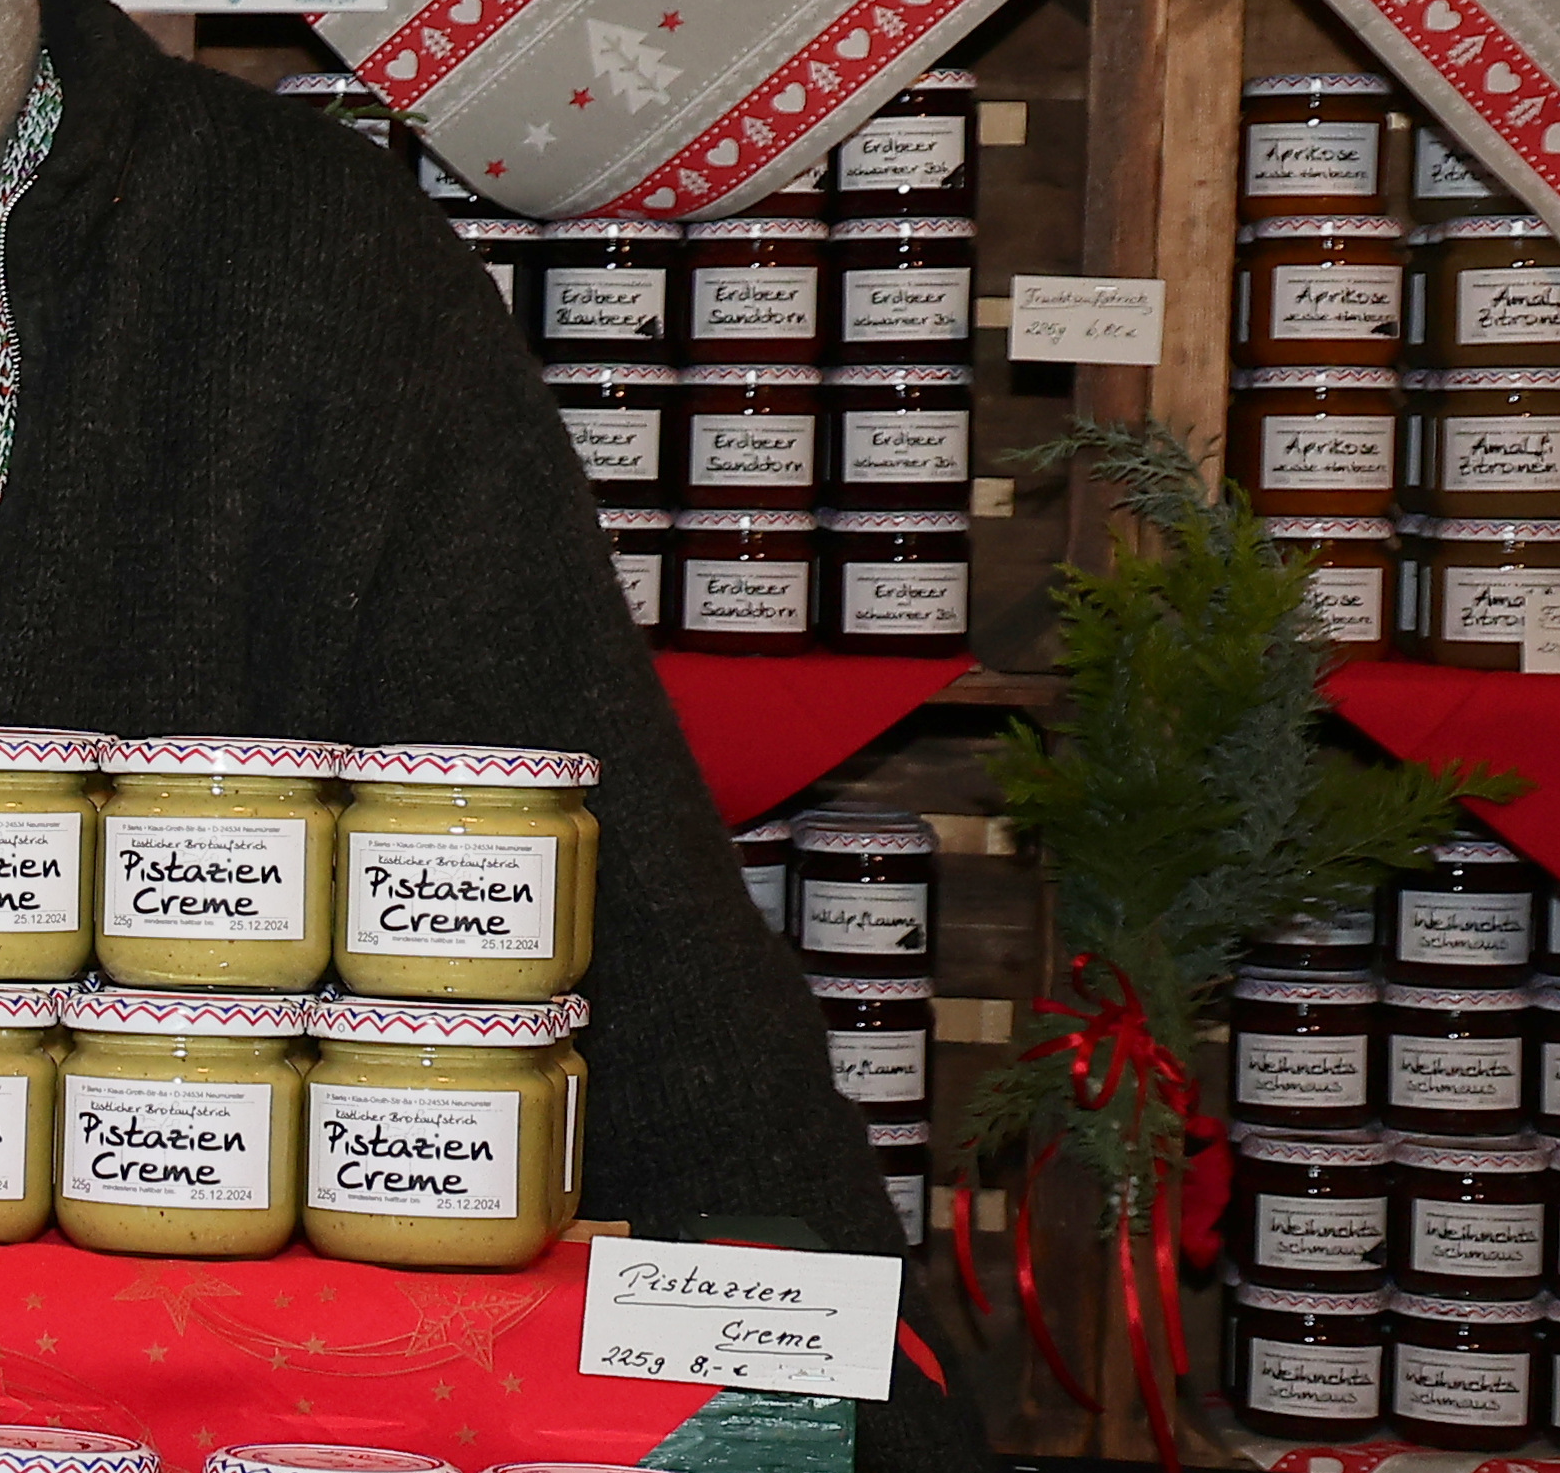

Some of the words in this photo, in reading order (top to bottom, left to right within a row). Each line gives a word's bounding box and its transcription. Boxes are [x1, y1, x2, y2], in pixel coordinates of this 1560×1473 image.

[119, 849, 283, 887] Pistazien
[131, 885, 261, 919] Creme
[368, 867, 536, 905] Pistazien
[378, 902, 512, 938] Creme
[79, 1112, 246, 1154] Pistazien
[323, 1121, 494, 1163] Pistazien
[91, 1152, 222, 1187] Creme
[335, 1161, 470, 1196] Creme
[437, 1199, 501, 1211] 25.12.2024
[618, 1263, 803, 1304] Pistazien
[721, 1319, 823, 1350] Creme
[601, 1346, 667, 1374] 225g
